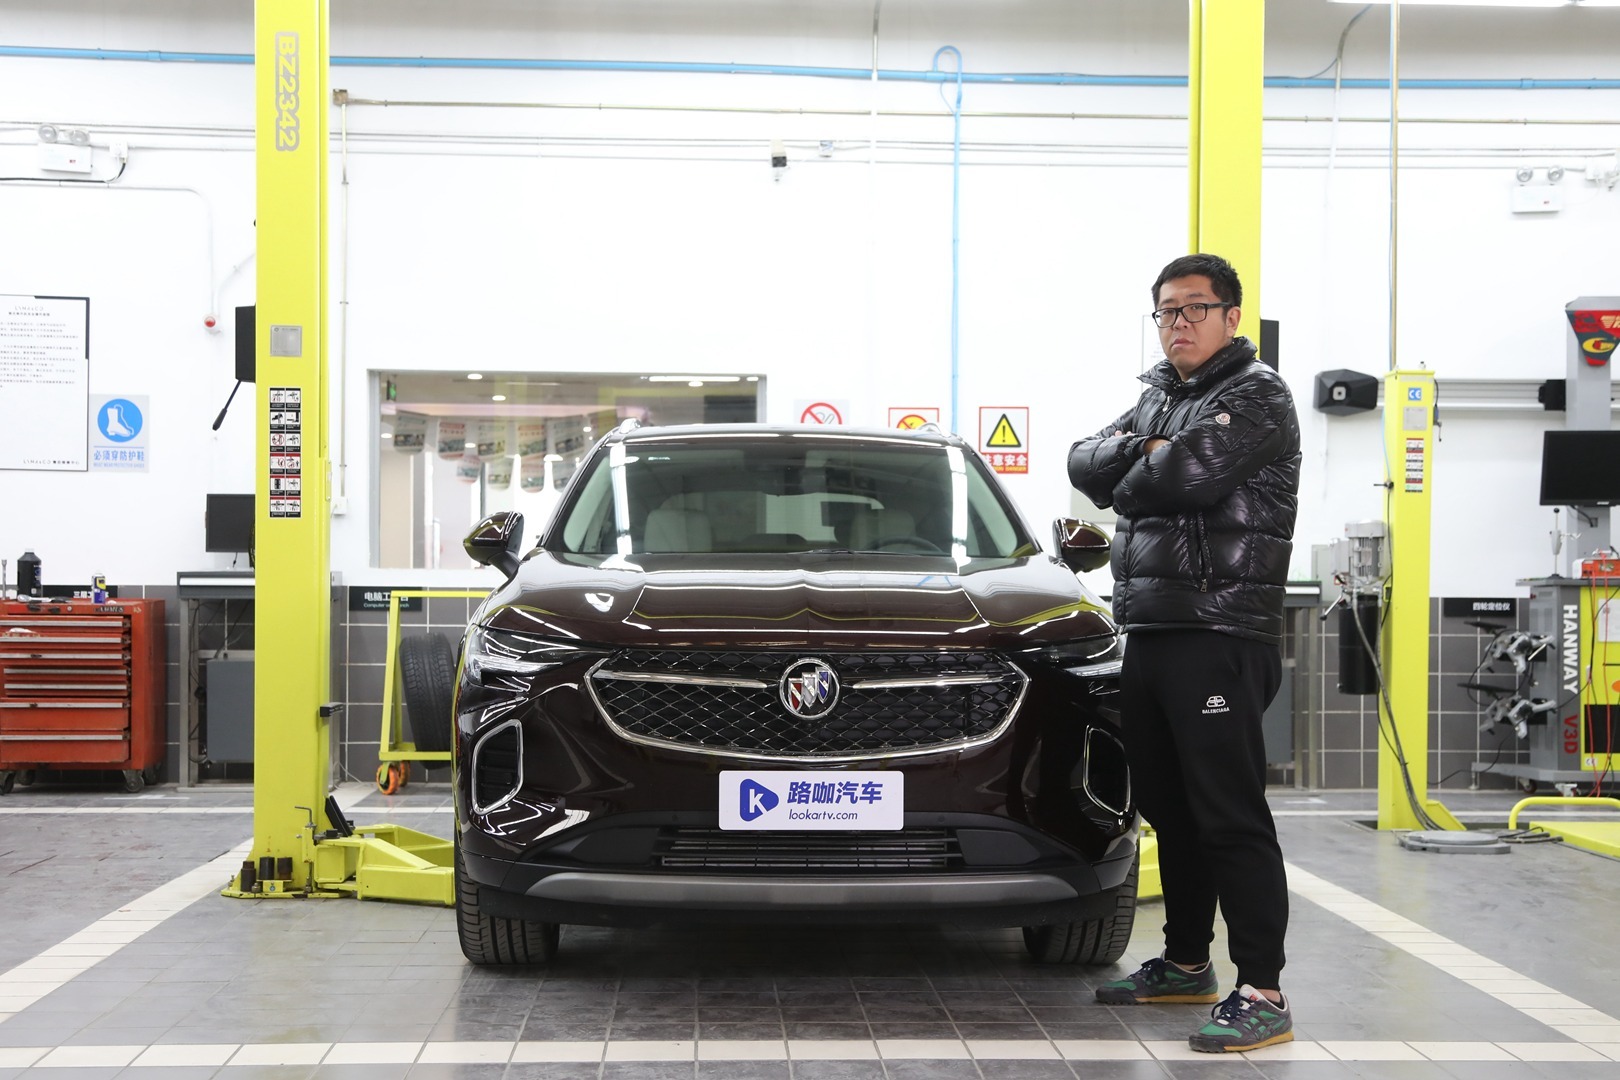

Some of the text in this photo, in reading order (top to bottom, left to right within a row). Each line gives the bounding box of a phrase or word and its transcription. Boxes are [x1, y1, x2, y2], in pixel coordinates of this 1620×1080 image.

[276, 33, 298, 150] BZ2342
[93, 450, 145, 461] 必须穿防护鞋
[364, 591, 409, 601] 电脑工
[1563, 604, 1578, 694] HANWAY
[1563, 714, 1578, 754] V3D
[787, 781, 883, 804] 路咖汽车
[788, 809, 858, 820] lookartv.com
